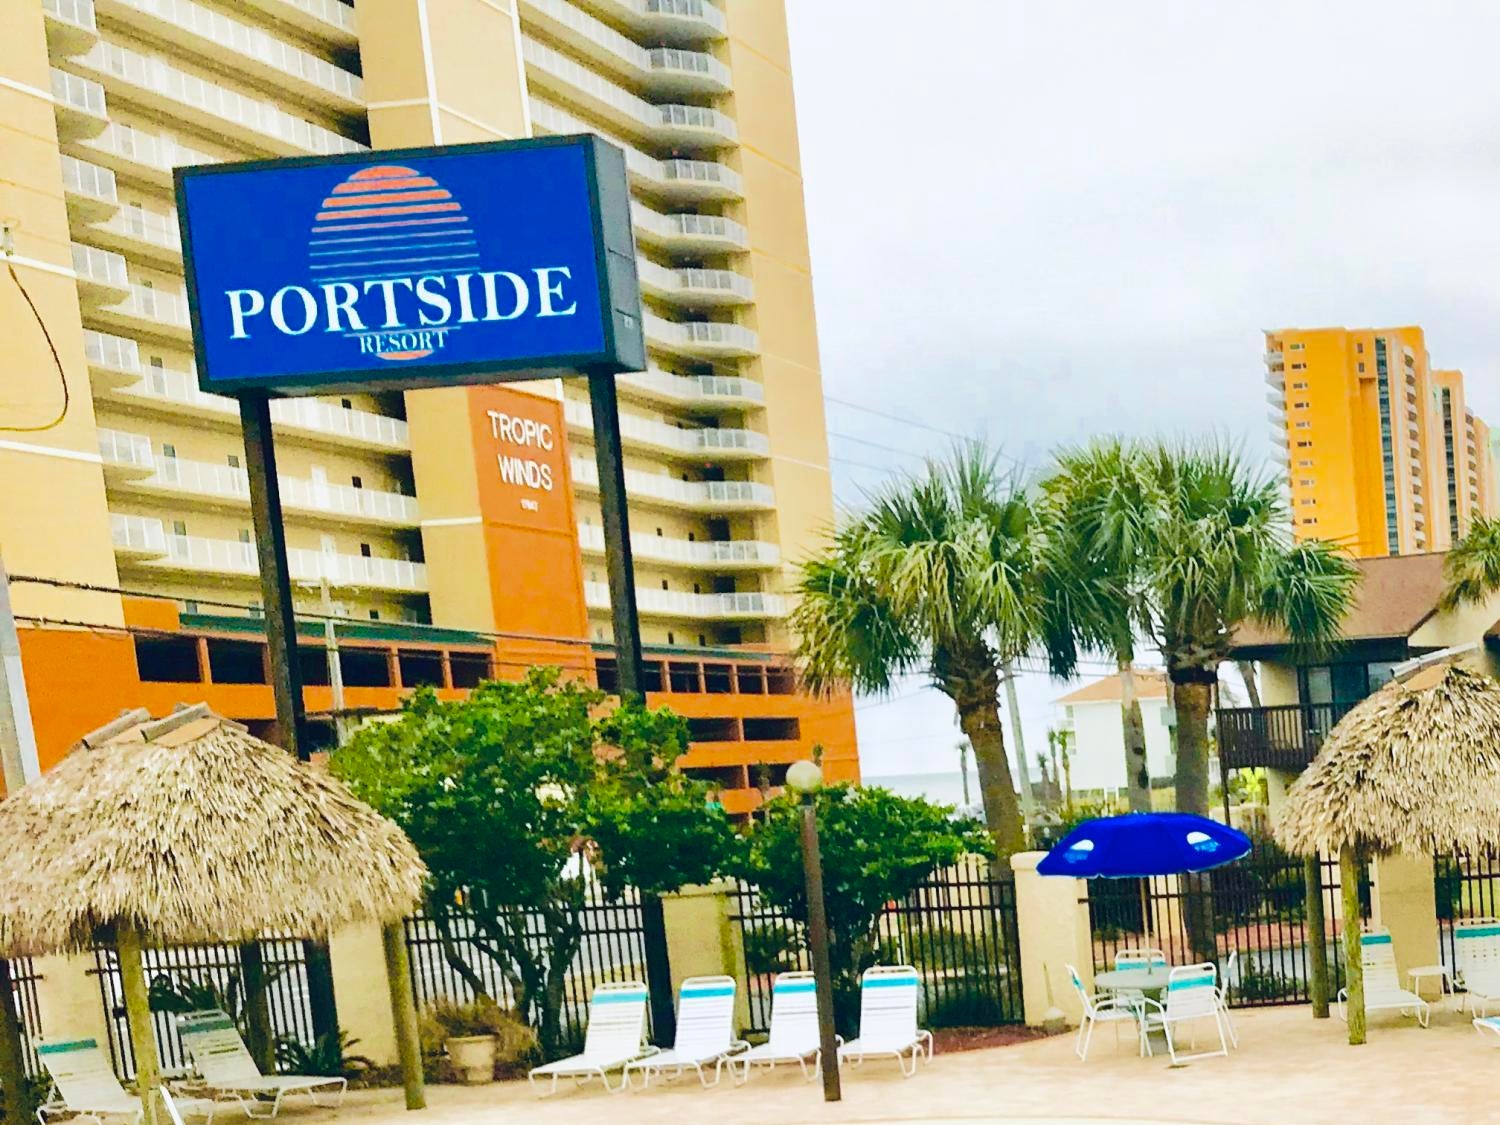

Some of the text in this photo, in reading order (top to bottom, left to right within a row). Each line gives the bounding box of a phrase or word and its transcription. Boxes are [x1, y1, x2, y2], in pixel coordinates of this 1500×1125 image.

[224, 266, 577, 340] PORTSIDE
[359, 331, 449, 354] RESORT
[486, 409, 553, 451] TROPIC
[497, 453, 553, 491] WINDS
